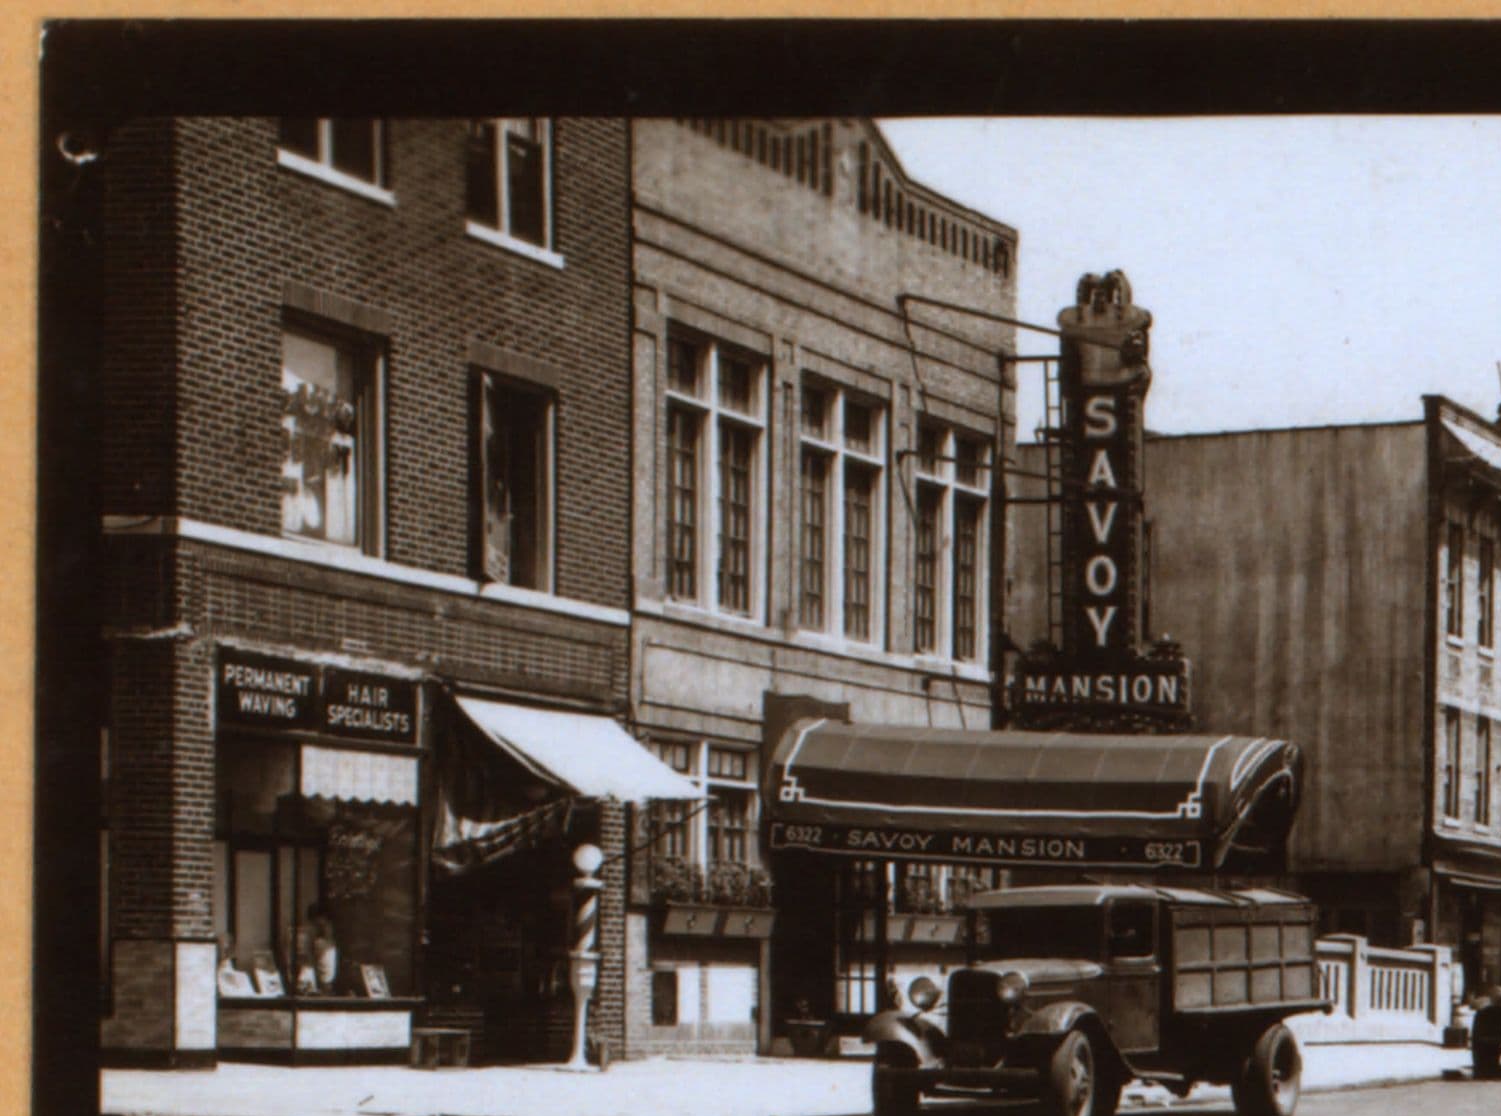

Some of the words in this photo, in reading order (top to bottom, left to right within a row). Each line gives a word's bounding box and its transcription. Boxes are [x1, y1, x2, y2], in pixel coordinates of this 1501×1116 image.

[1084, 396, 1119, 648] SAVOY
[223, 664, 312, 697] PERMANENT
[1024, 674, 1178, 704] MANSION
[238, 691, 297, 720] WAVING
[347, 683, 390, 708] HAIR
[327, 704, 410, 733] SPECIALISTS
[847, 829, 933, 850] SAVOY
[952, 836, 1086, 858] MANSION
